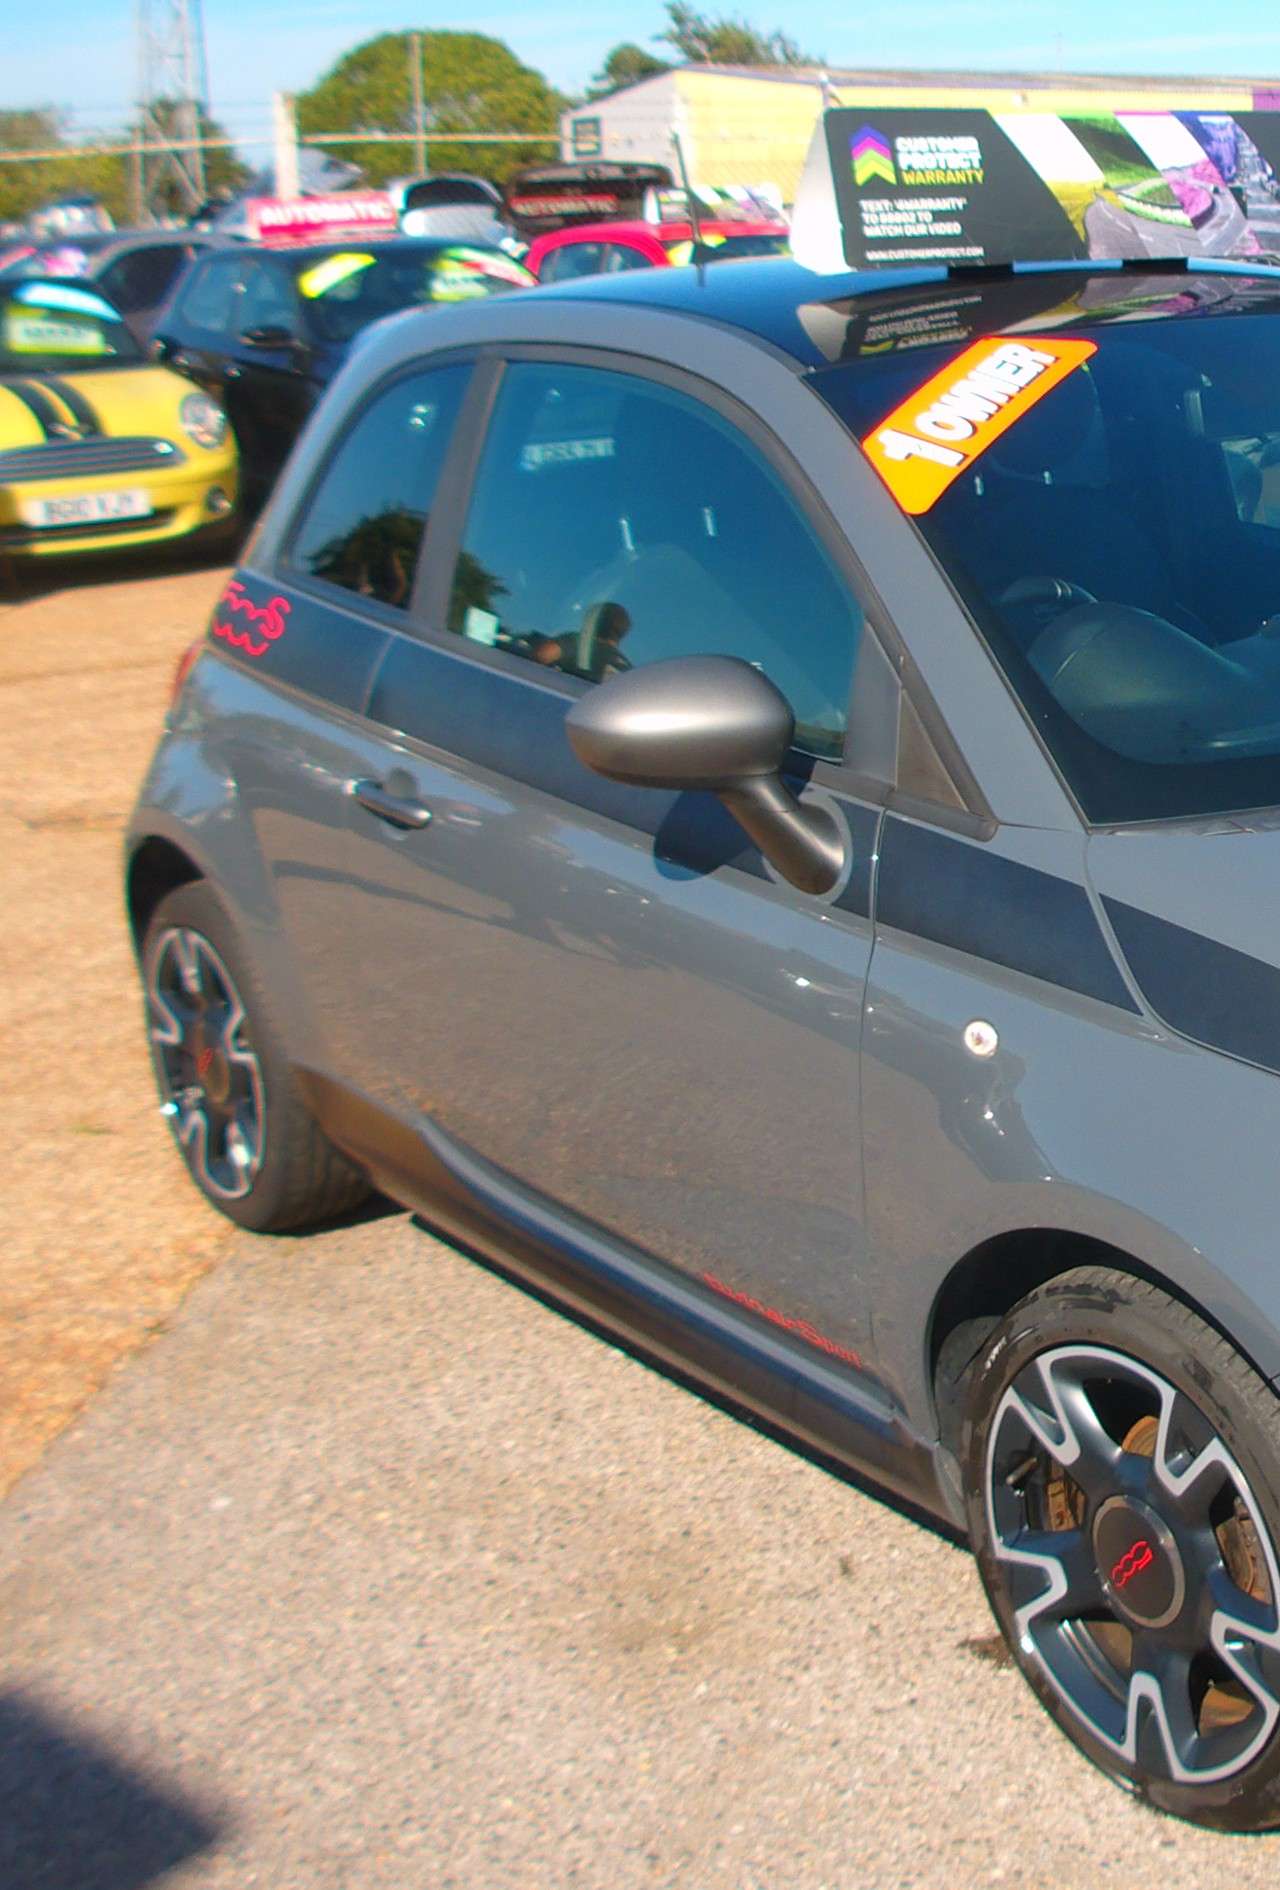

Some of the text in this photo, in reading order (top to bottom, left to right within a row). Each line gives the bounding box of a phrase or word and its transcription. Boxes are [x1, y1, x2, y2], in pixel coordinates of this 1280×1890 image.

[896, 136, 979, 152] CUSTOMER
[898, 152, 982, 169] PROTECT
[902, 169, 984, 184] WARRANTY
[260, 200, 392, 225] AUTOMATIC
[862, 212, 879, 224] TO
[917, 211, 932, 223] TO
[863, 222, 962, 237] WATCH OUR VIDEO
[877, 344, 1057, 467] 1 OWNER
